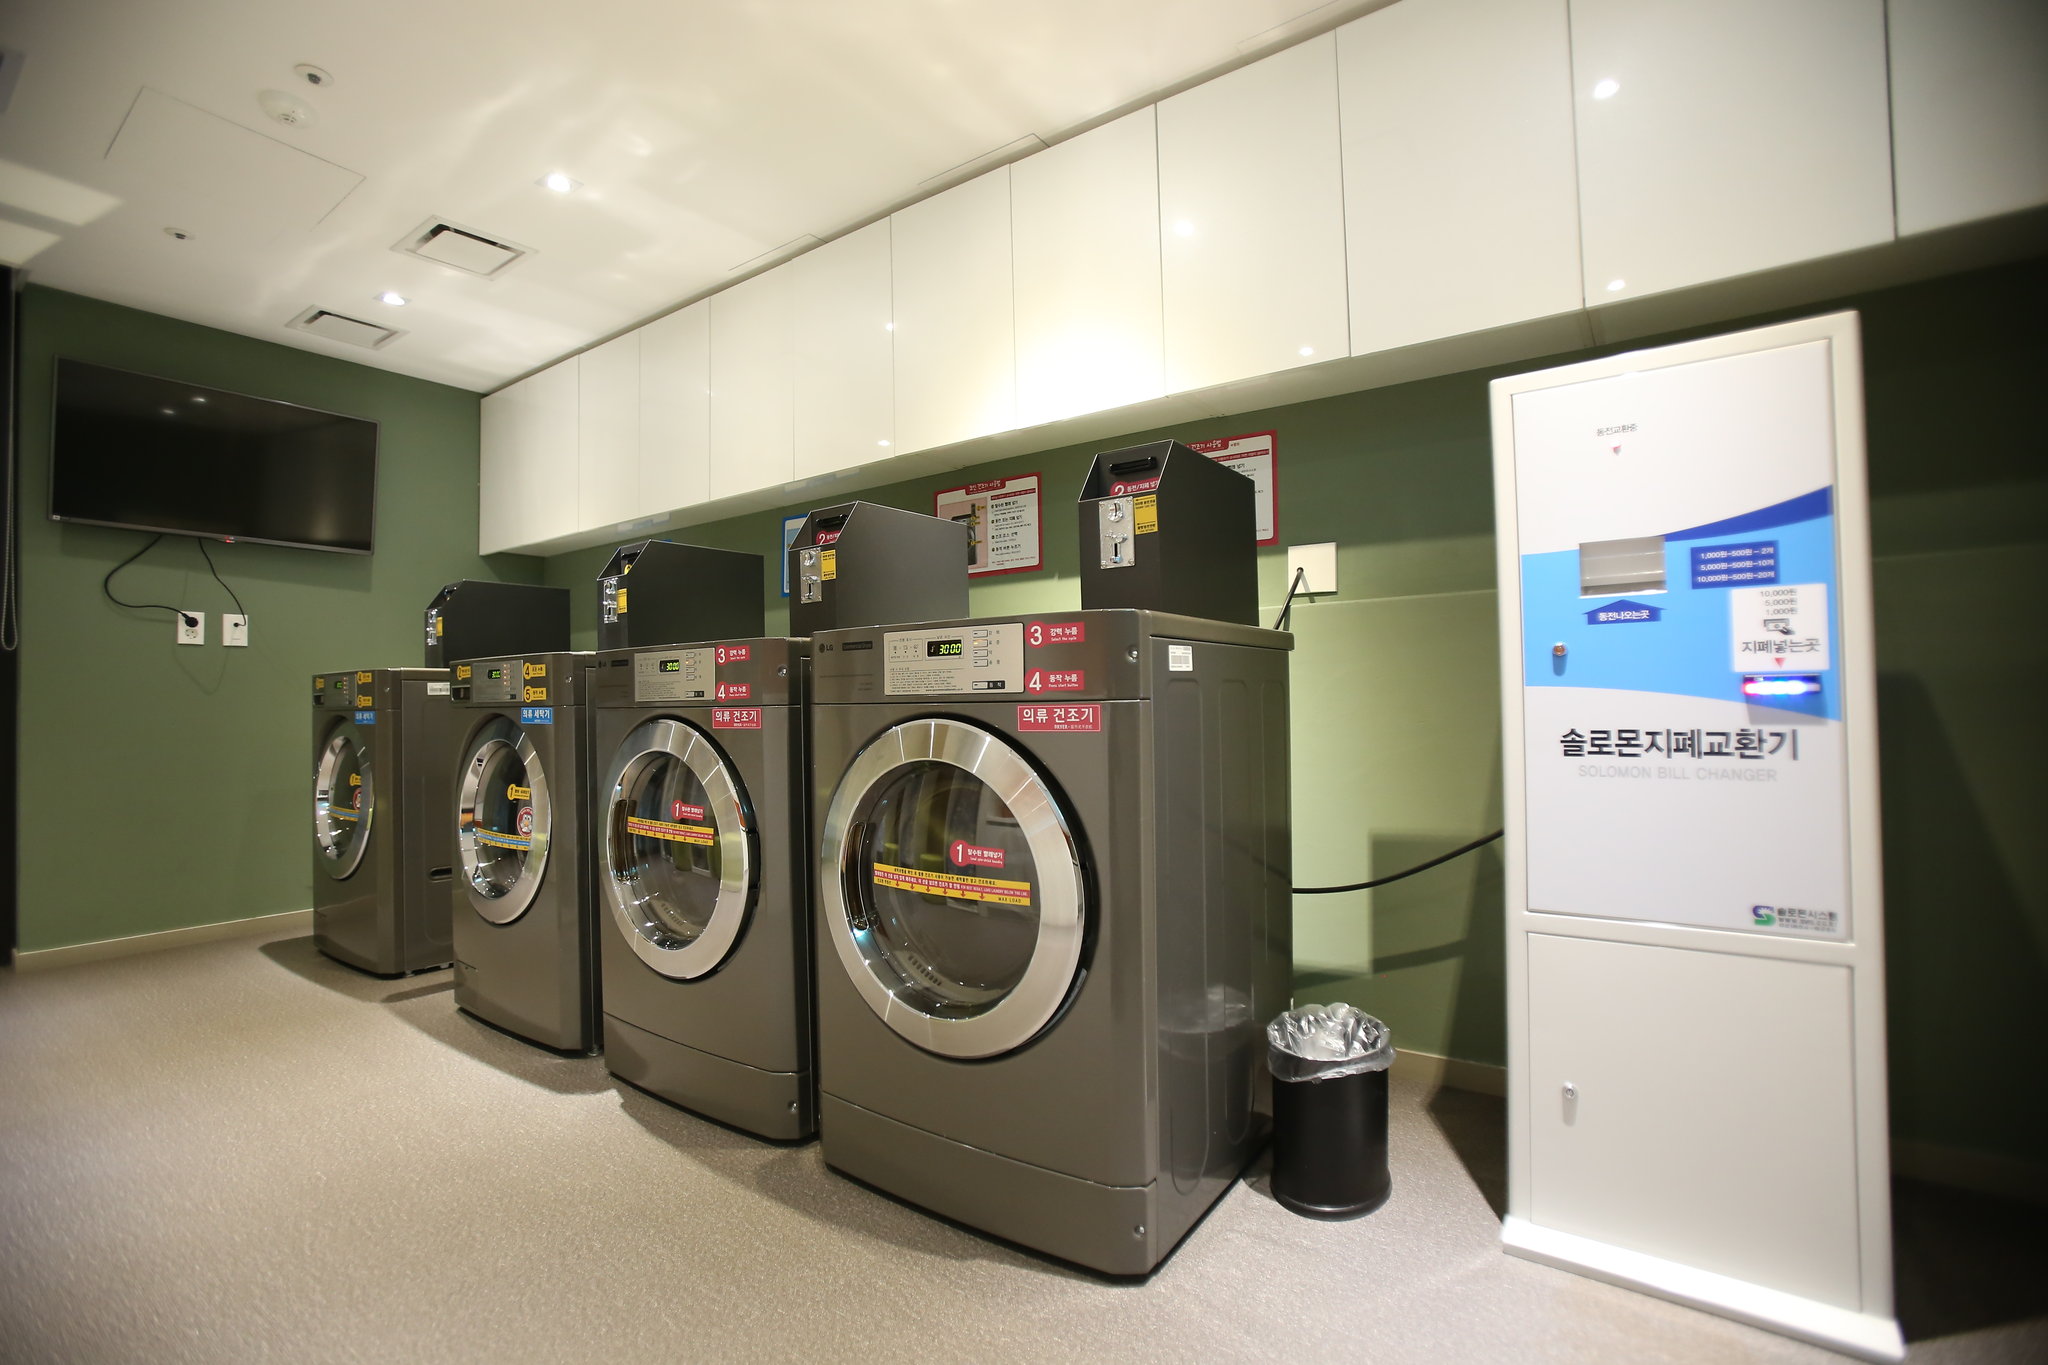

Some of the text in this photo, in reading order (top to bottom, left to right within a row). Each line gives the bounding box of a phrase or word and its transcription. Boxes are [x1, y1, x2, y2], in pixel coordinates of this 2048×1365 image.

[1115, 485, 1125, 495] 2
[1760, 588, 1797, 598] 10,000원
[1765, 598, 1798, 607] 5,000원
[1599, 609, 1650, 622] 동전나오는곳
[1766, 607, 1798, 615] 1,000원
[1030, 625, 1043, 645] 3
[1065, 626, 1078, 635] 누름
[1742, 638, 1821, 654] 지폐넣는곳
[718, 648, 727, 663] 3
[524, 666, 530, 678] 4
[1049, 673, 1078, 683] 동작 누름
[1029, 671, 1042, 691] 4
[525, 688, 531, 700] 5
[718, 684, 727, 699] 4
[715, 710, 757, 723] 의류 건조기
[1023, 707, 1093, 724] 의류 건조기
[1560, 728, 1800, 761] 솔로몬지폐교환기
[1578, 764, 1778, 783] SOLOMON BILL CHANGER
[675, 802, 680, 817] 1
[956, 843, 963, 863] 1
